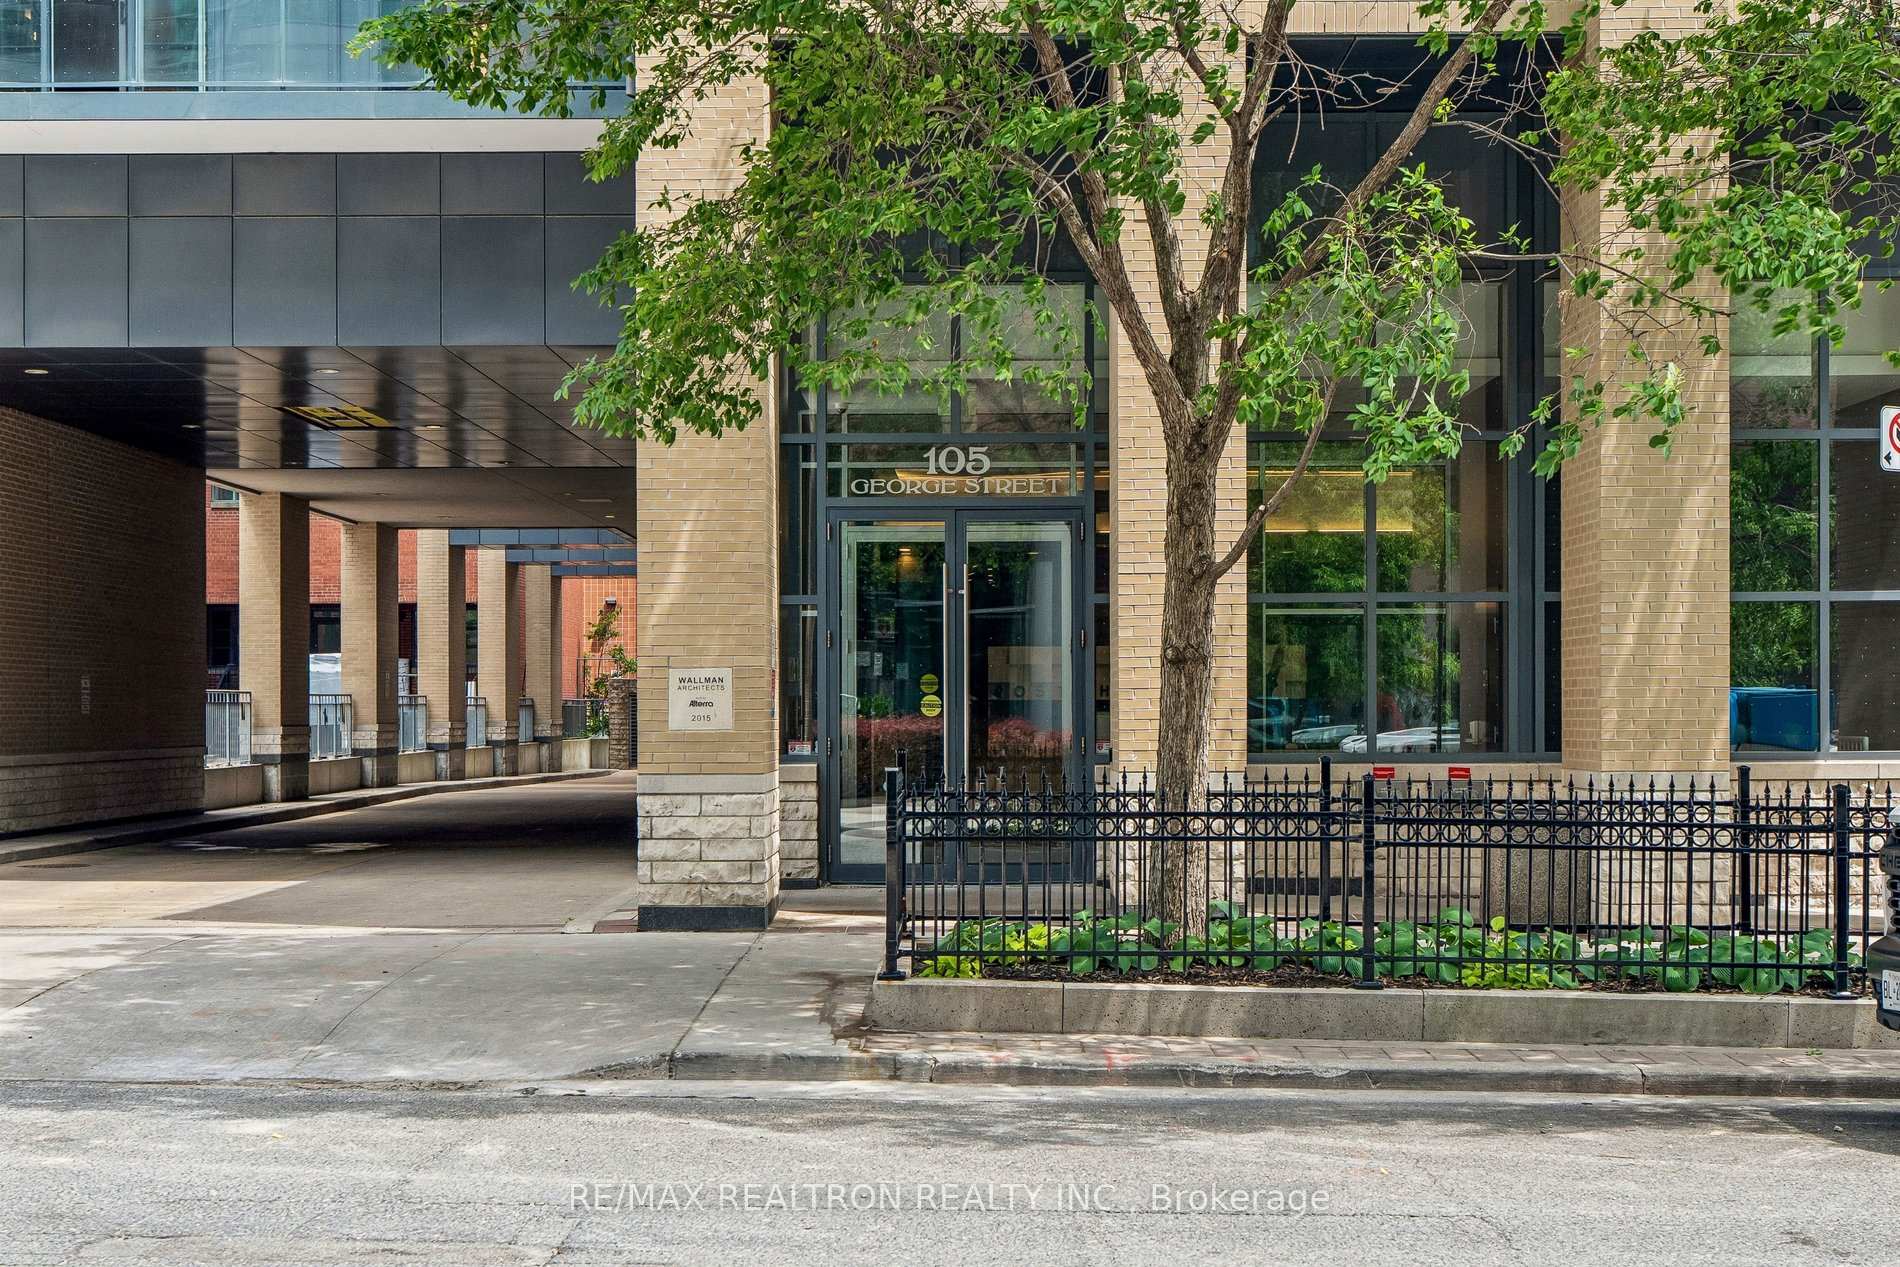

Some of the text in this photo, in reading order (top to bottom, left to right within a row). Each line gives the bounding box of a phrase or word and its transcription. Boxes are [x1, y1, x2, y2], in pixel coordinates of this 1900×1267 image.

[922, 446, 991, 475] 105
[850, 478, 1063, 495] GEORGE STREET
[678, 676, 724, 684] WALLMAN
[691, 714, 712, 722] 2015
